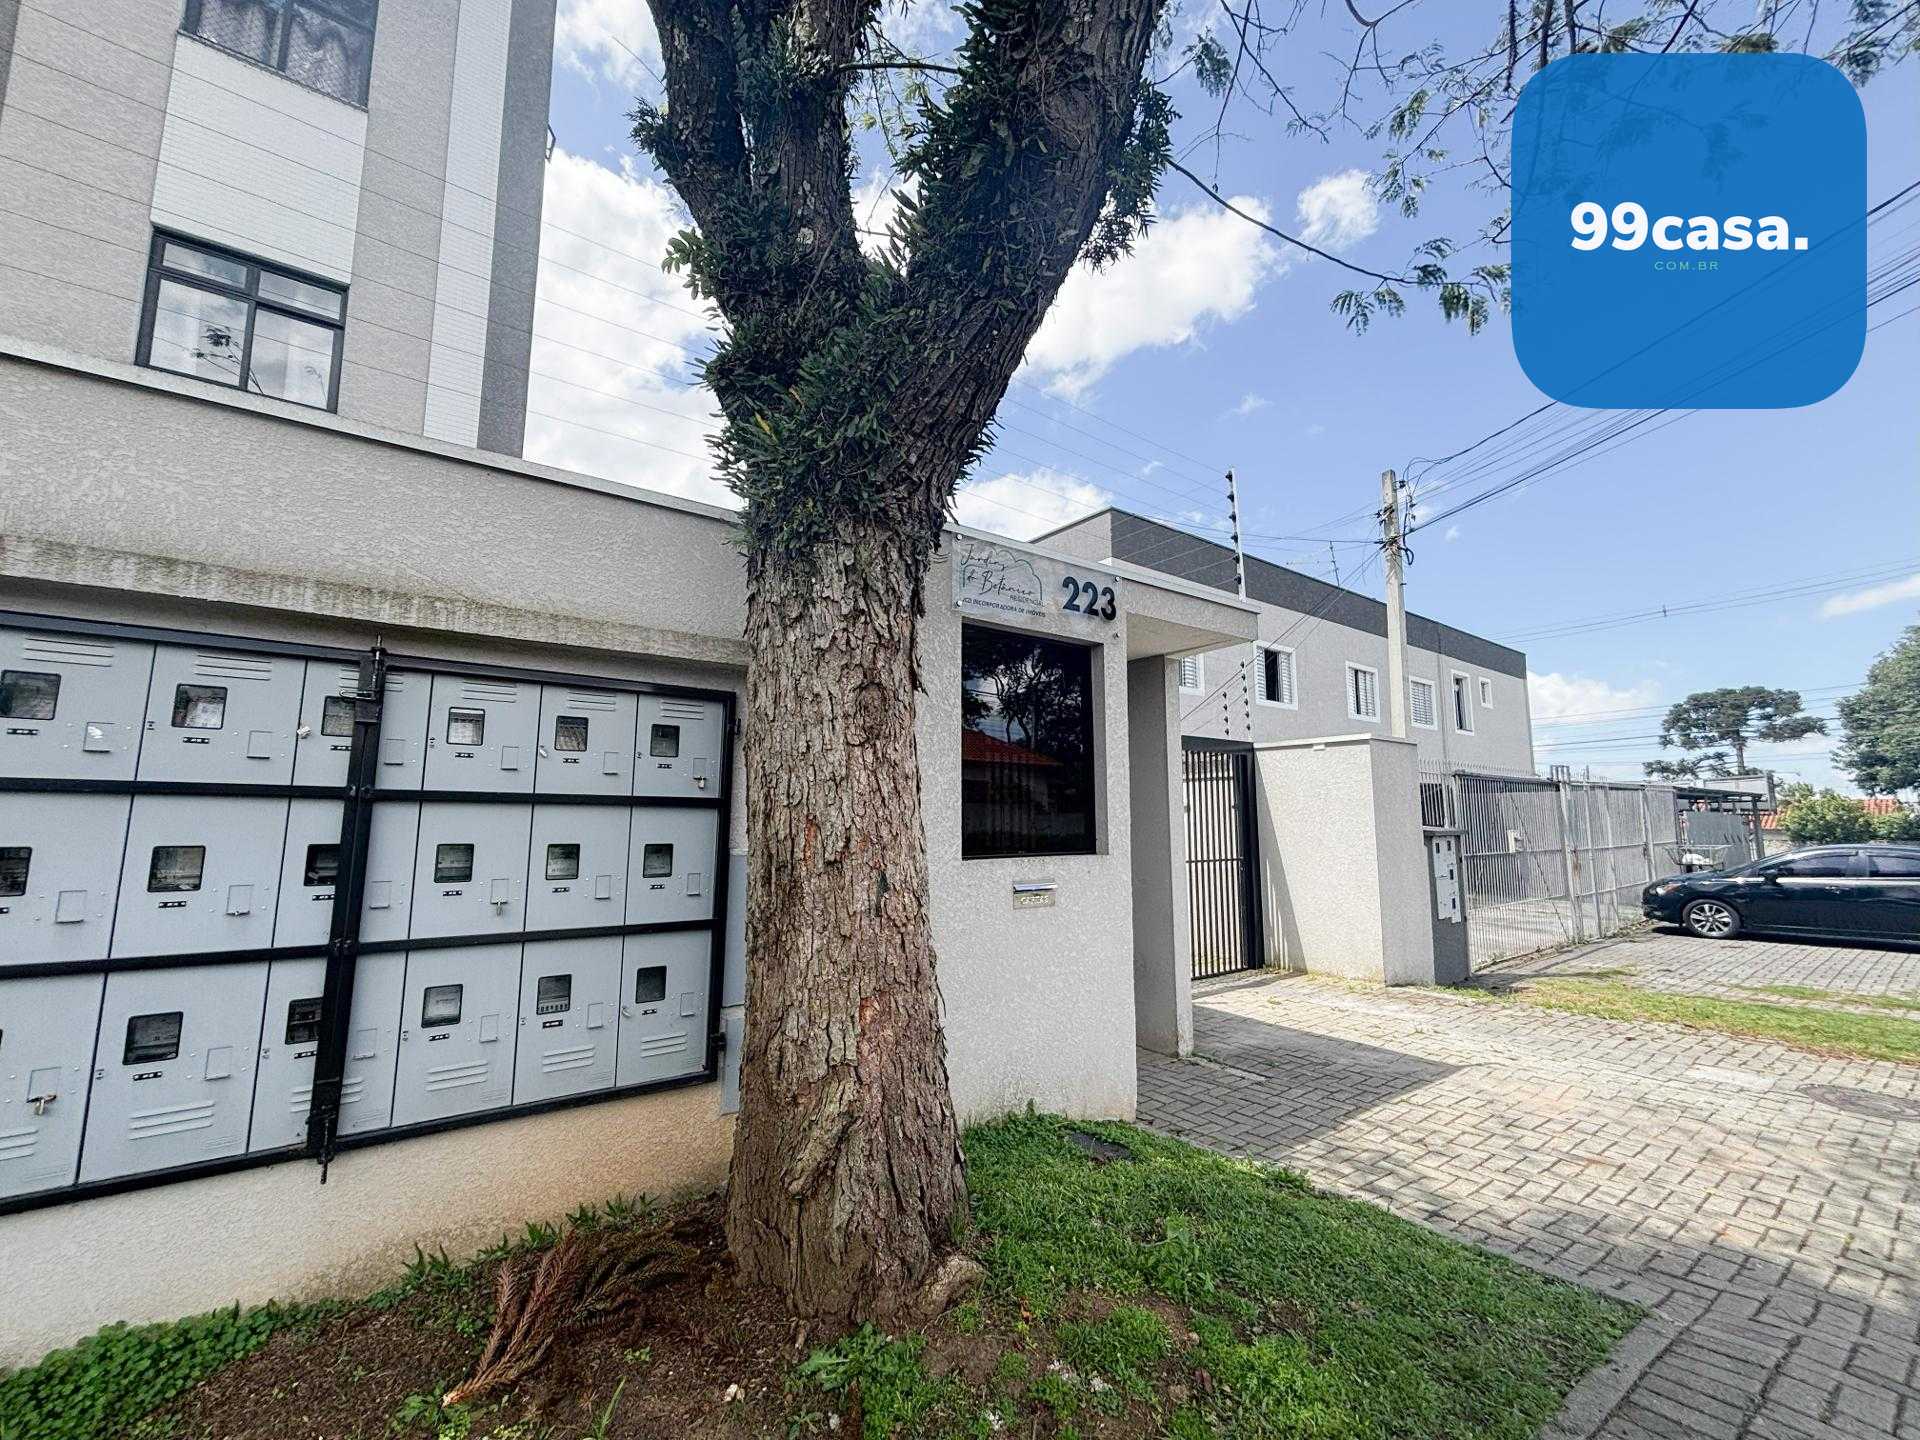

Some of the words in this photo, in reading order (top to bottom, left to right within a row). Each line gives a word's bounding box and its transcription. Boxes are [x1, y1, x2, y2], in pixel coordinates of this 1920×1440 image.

[972, 598, 1017, 612] INCORPORADORA
[1009, 594, 1046, 608] RESIDENCIAL
[1062, 576, 1117, 621] 223
